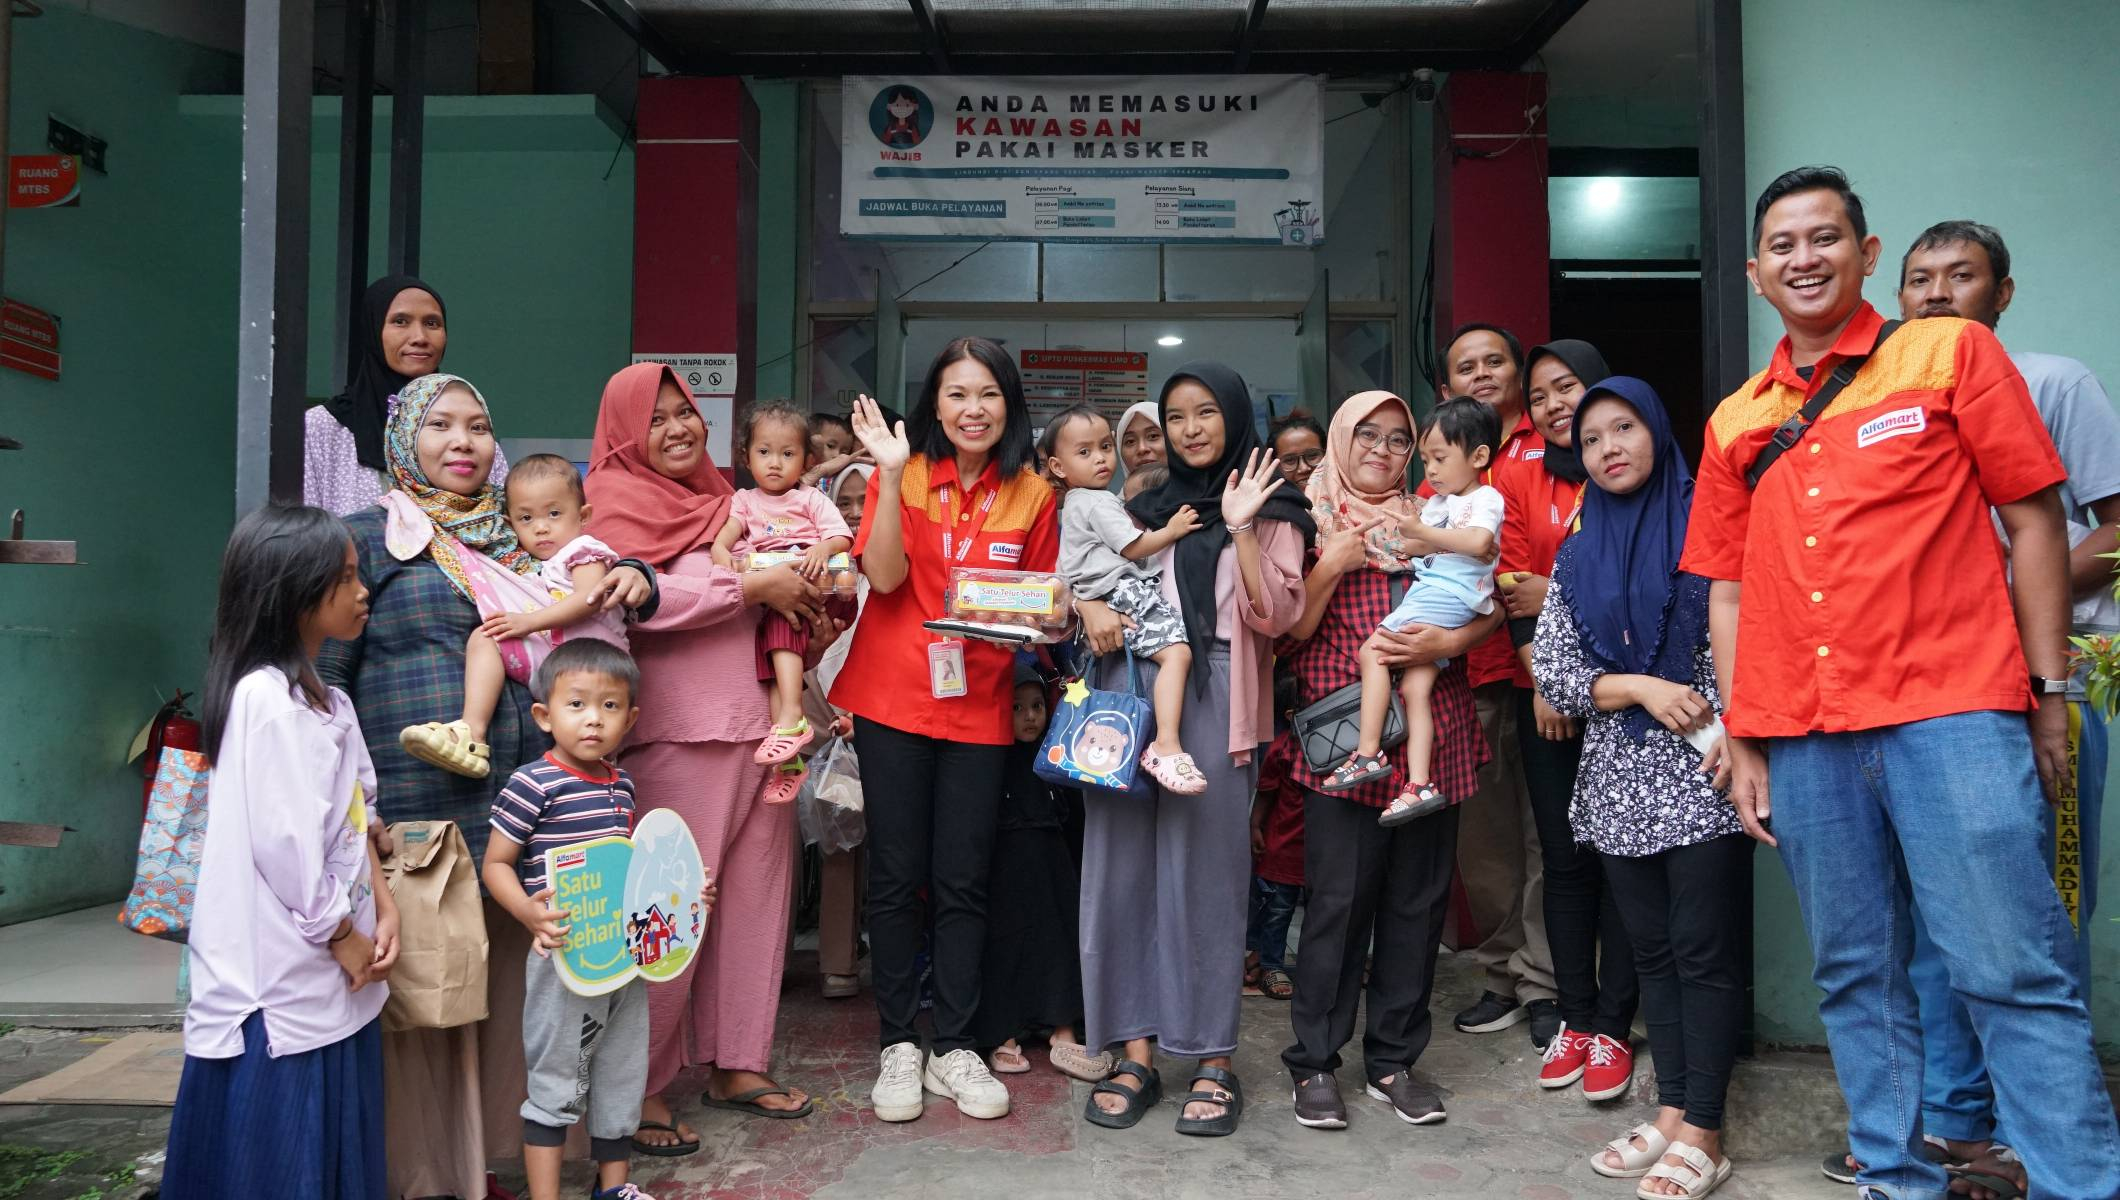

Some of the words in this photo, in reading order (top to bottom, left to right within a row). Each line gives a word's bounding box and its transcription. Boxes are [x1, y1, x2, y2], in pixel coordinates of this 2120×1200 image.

[956, 95, 1049, 113] ANDA
[1069, 94, 1259, 114] MEMASUKI
[955, 117, 1142, 137] KAWASAN
[880, 150, 922, 162] WAJIB
[955, 141, 1055, 159] PAKAI
[1073, 141, 1210, 159] MASKER
[19, 168, 58, 178] RUANG
[18, 184, 50, 194] MTBS
[1025, 185, 1058, 193] Pelayanan
[1059, 185, 1073, 194] Pagi
[1145, 184, 1177, 193] Pelayanan
[866, 201, 909, 212] JADWAL
[911, 202, 938, 212] BUKA
[941, 203, 1003, 214] PELAYANAN
[1861, 411, 1919, 437] Alfamart
[981, 587, 999, 596] Satu
[556, 851, 585, 863] Alfamart
[559, 872, 601, 898] Satu
[560, 896, 608, 924] Telur
[561, 908, 623, 953] Sehari
